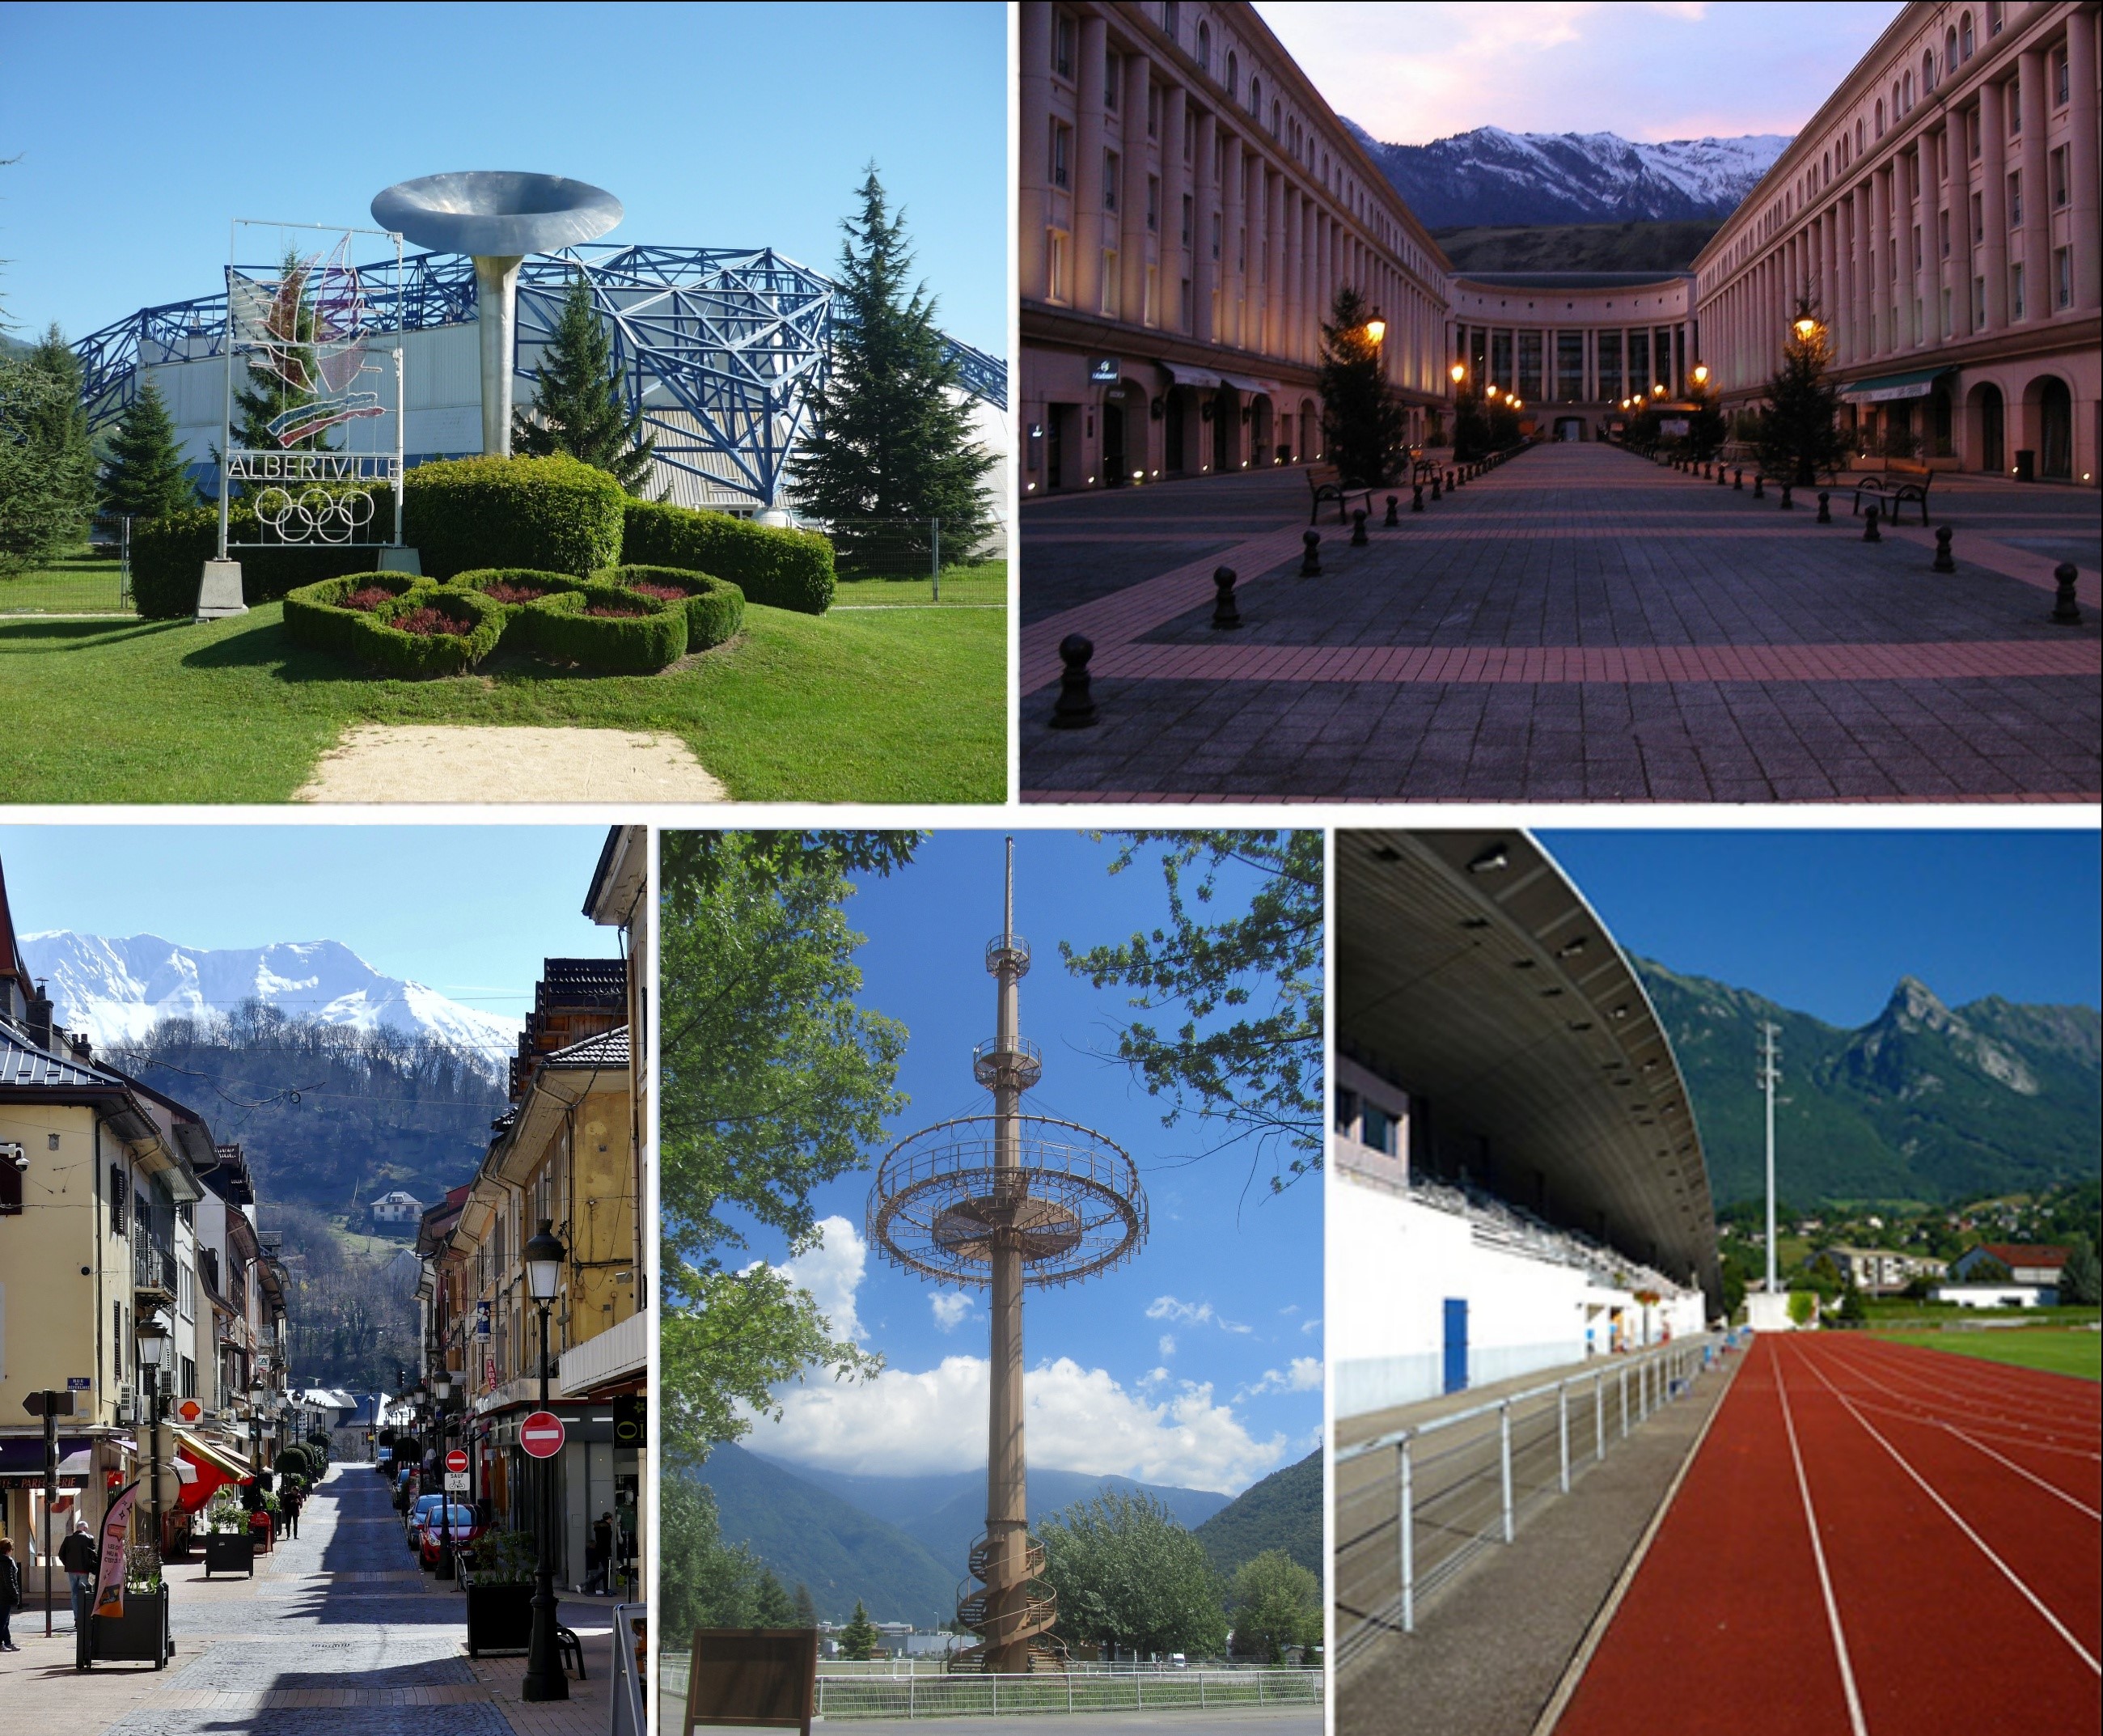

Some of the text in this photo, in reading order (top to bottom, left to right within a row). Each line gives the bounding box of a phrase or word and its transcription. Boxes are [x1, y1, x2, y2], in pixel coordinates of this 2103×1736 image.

[229, 455, 400, 479] ALBERTVILLE
[488, 1360, 496, 1391] TABAC
[0, 1477, 76, 1488] TÉ PARFERIE
